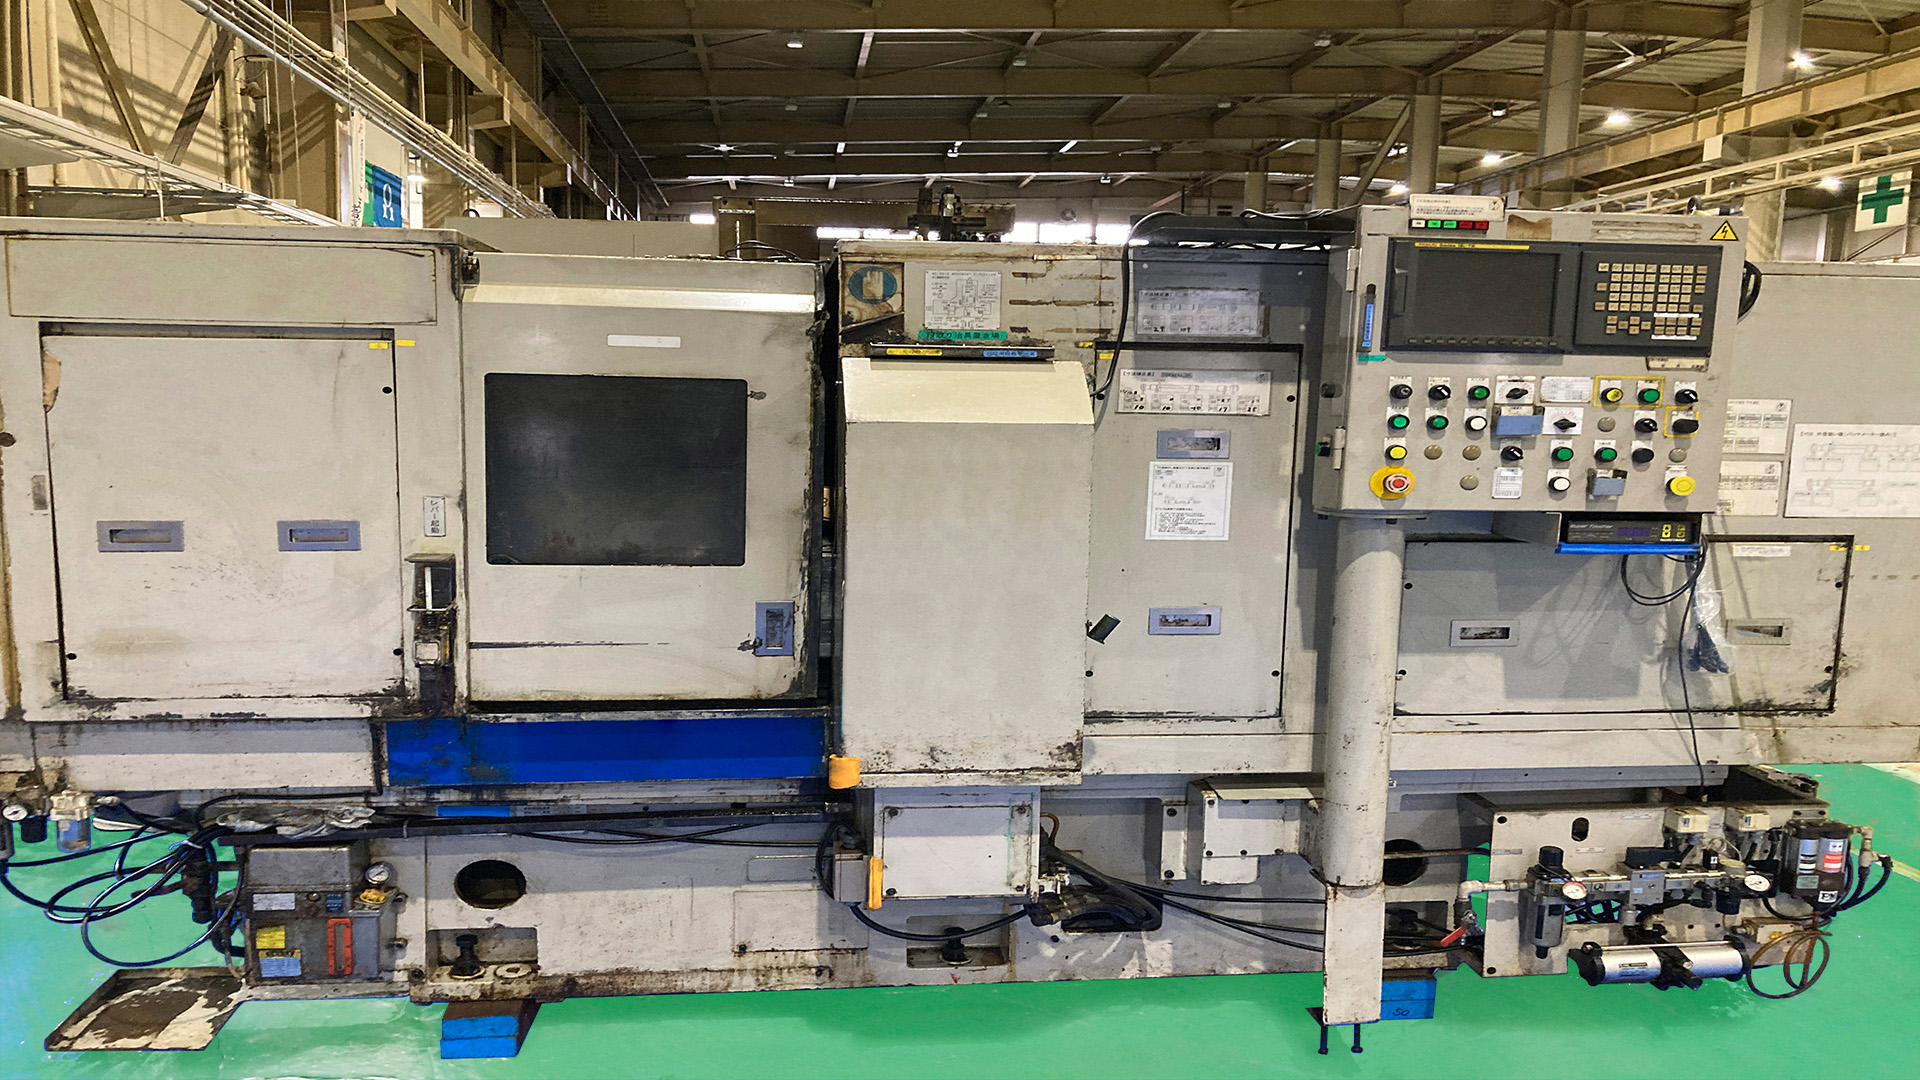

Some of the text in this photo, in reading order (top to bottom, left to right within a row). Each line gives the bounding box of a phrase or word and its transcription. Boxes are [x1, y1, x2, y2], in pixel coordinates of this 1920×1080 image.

[429, 499, 441, 534] レバー起動
